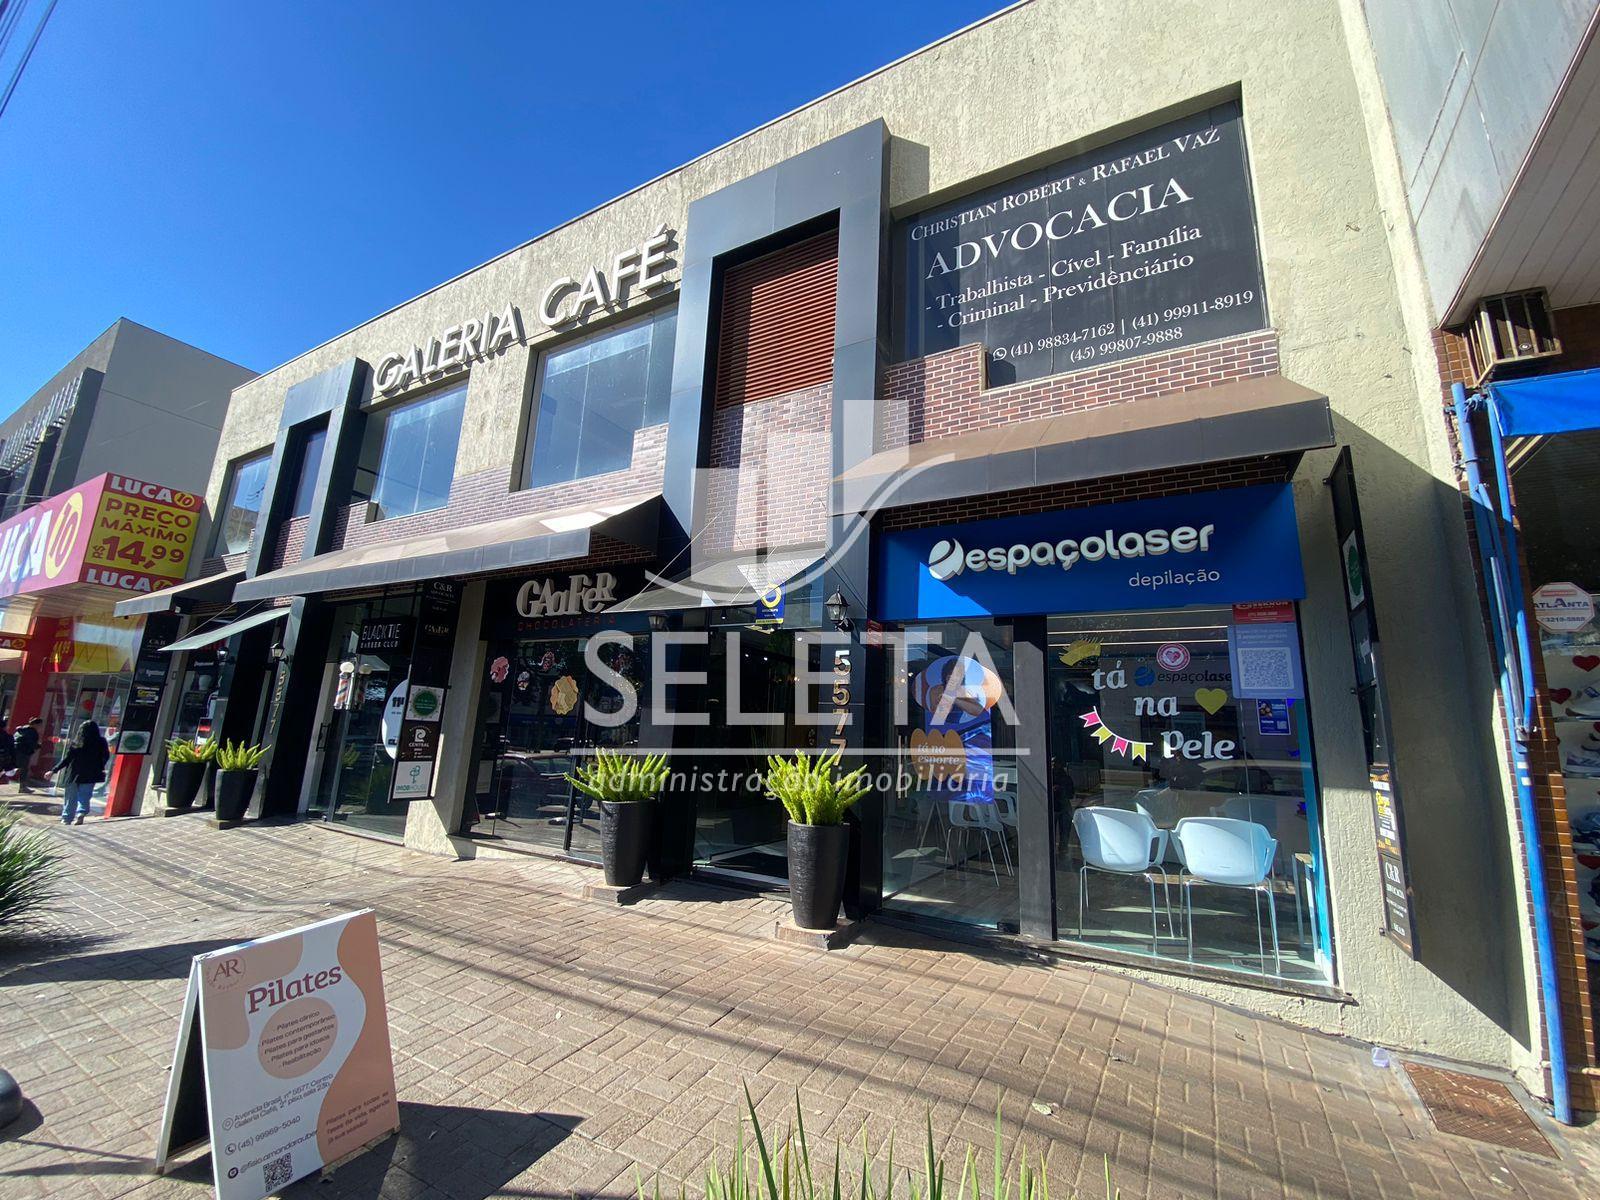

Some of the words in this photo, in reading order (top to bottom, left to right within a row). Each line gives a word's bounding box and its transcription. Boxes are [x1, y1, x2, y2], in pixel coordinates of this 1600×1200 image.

[911, 202, 998, 242] CHRISTIAN
[1001, 176, 1075, 213] ROBERT
[1078, 177, 1088, 187] &
[1092, 146, 1171, 183] RAFAEL
[1172, 128, 1220, 156] VAZ
[925, 177, 1194, 280] ADVOCACIA
[936, 271, 1034, 311] Trabalhista
[1050, 249, 1102, 279] Cível
[1121, 224, 1203, 260] Família
[948, 296, 1026, 329] Criminal
[1043, 252, 1195, 304] Previdênciário
[372, 301, 523, 394] GALERIA
[539, 222, 671, 327] CAFÉ
[1010, 339, 1034, 360] (41)
[1037, 321, 1116, 352] 98834-7162
[1132, 311, 1160, 331] (41)
[1163, 289, 1255, 323] 99911-8919
[1070, 346, 1096, 364] (45)
[1099, 326, 1184, 357] 99807-9888
[110, 475, 173, 503] LUCA
[100, 517, 188, 544] MÁXIMO
[0, 509, 53, 584] UCA
[102, 535, 185, 570] 14,99
[965, 523, 1215, 576] espaçolaser
[86, 568, 152, 592] LUCA
[1128, 569, 1220, 591] depilação
[362, 624, 388, 641] BLACK
[1091, 660, 1128, 690] tá
[1157, 669, 1232, 684] espaçolase
[830, 649, 852, 767] 5577
[1134, 696, 1180, 717] na
[1160, 730, 1236, 761] Pele
[213, 958, 242, 982] AR
[247, 966, 343, 1015] Pilates
[277, 1018, 299, 1031] Pilates
[261, 1034, 284, 1046] Pilates
[264, 1042, 287, 1055] Pilates
[271, 1049, 293, 1062] Pilates
[234, 1105, 263, 1121] Avenida
